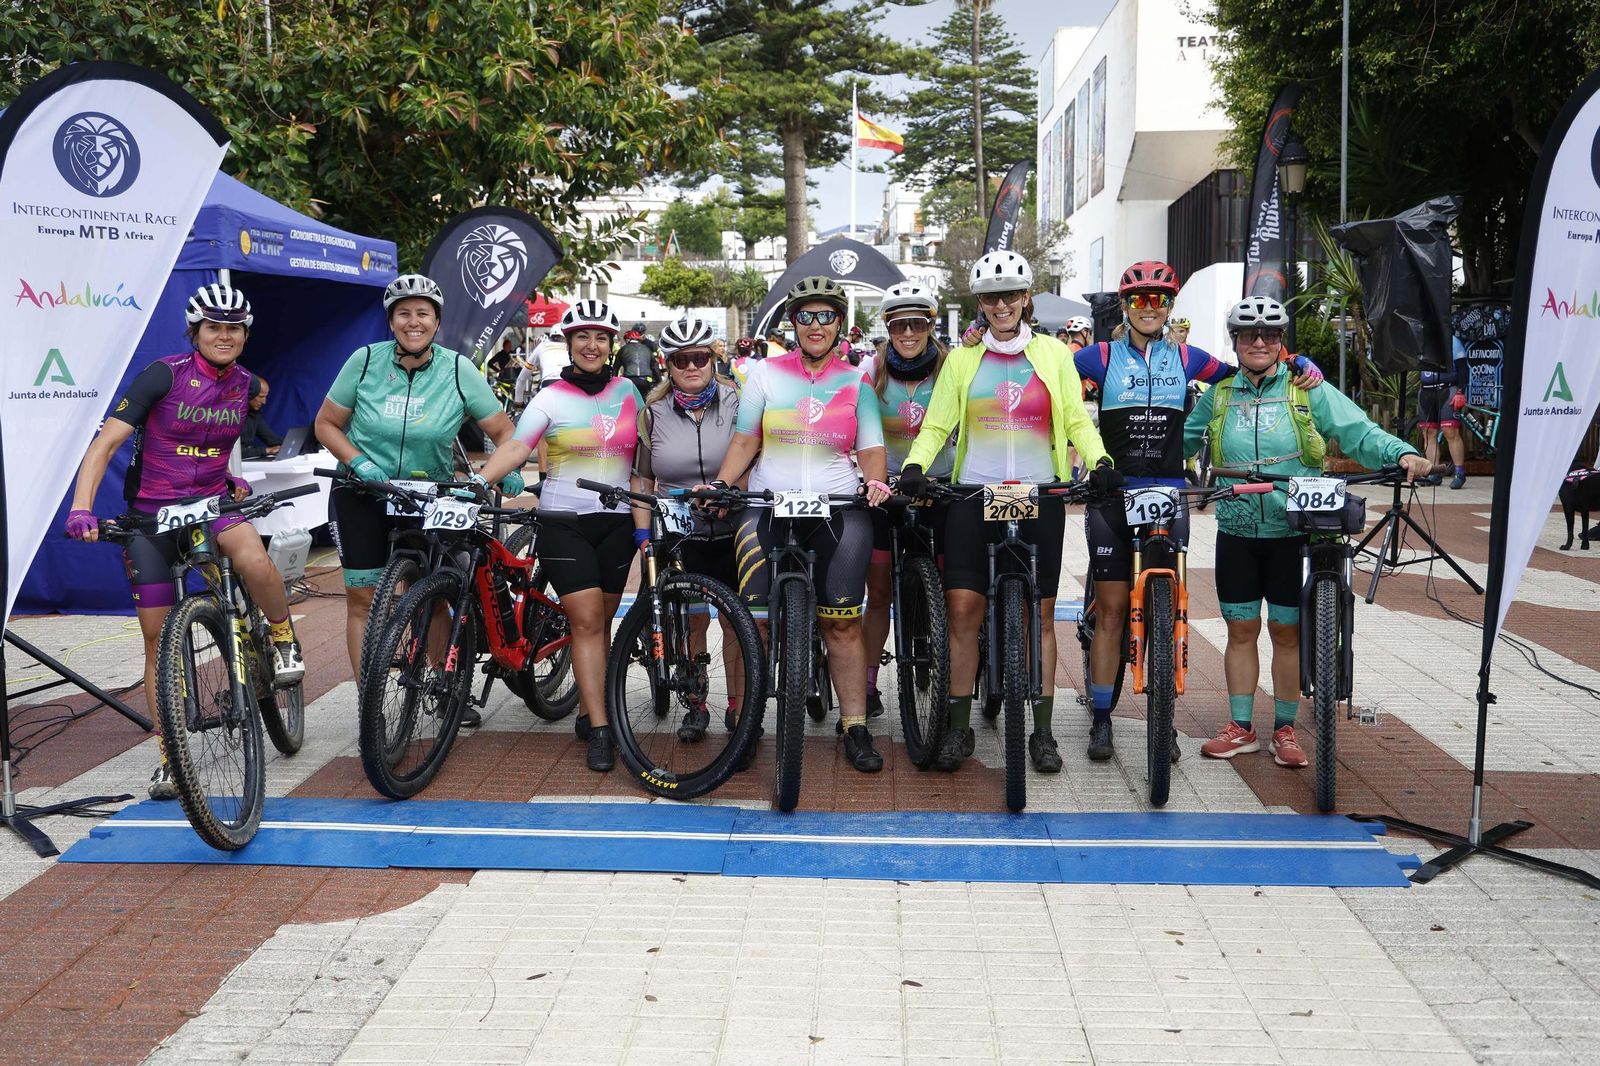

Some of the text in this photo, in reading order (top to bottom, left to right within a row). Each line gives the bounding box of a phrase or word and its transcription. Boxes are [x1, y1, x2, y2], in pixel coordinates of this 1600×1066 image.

[13, 202, 177, 226] INTERCONTINENTAL RACE
[38, 224, 154, 241] Europa MTB Africa
[1568, 230, 1593, 242] Europa
[14, 278, 142, 311] Andalucía
[39, 390, 50, 398] de
[53, 389, 98, 398] Andalucía
[177, 401, 240, 426] WOMAN
[1524, 408, 1543, 416] Junta
[785, 500, 822, 515] 122
[1298, 492, 1336, 508] 084
[433, 511, 467, 528] 029
[1136, 502, 1174, 520] 192
[818, 608, 853, 616] RUTA
[640, 771, 678, 790] MAXXIS
